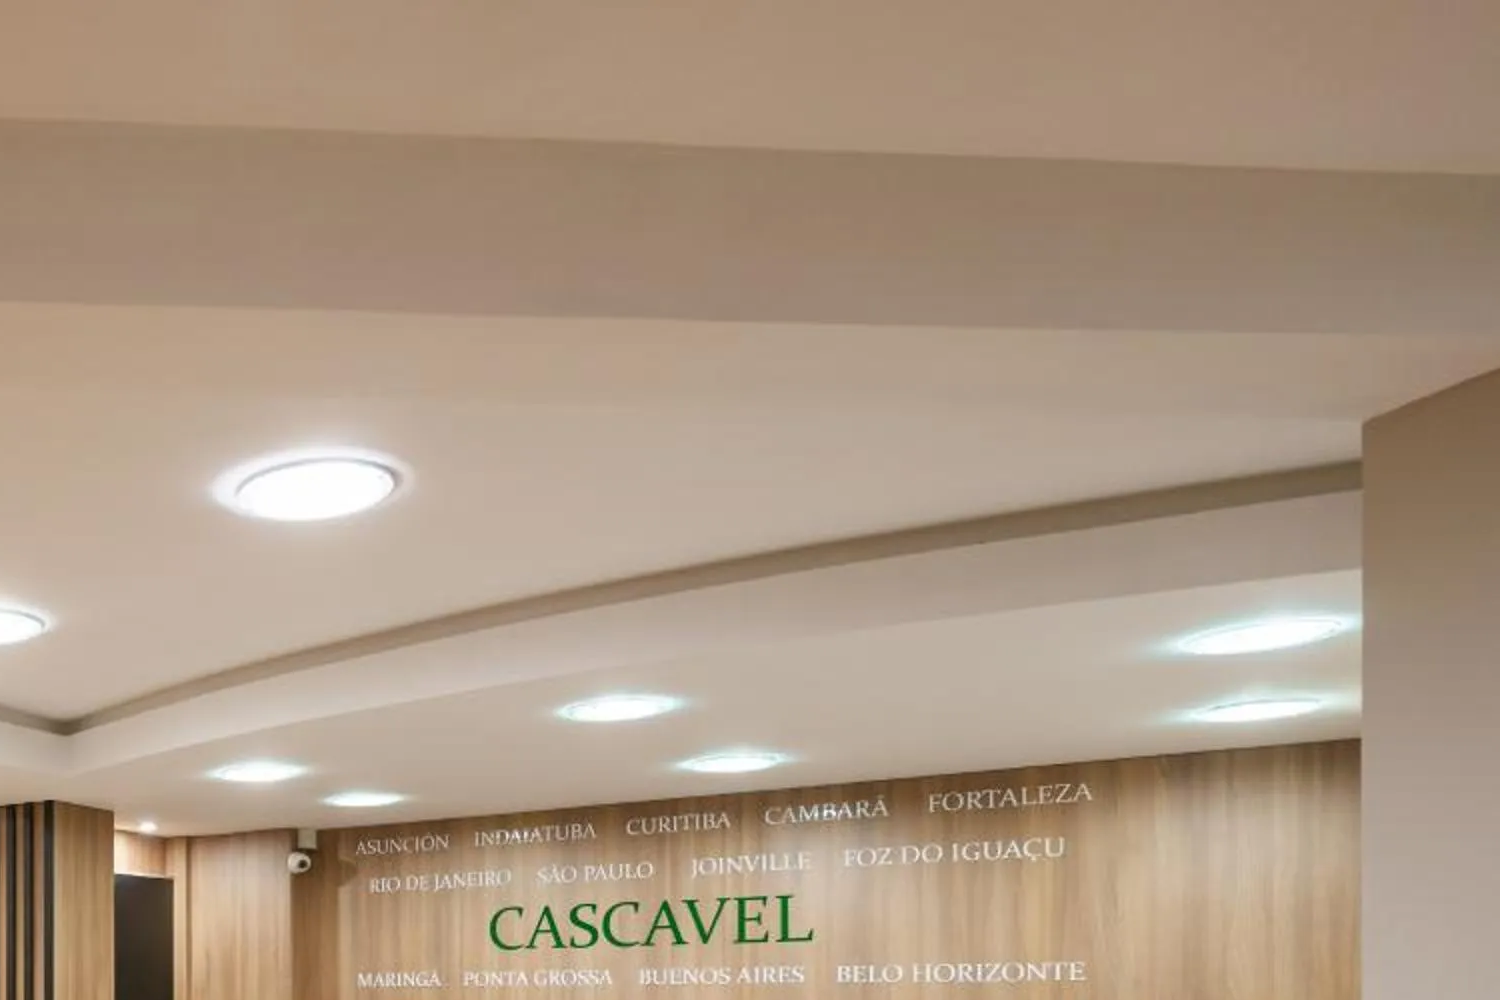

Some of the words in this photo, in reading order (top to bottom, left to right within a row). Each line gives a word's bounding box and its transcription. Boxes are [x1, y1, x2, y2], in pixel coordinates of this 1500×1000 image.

[474, 822, 597, 848] INDAIATUBA
[626, 811, 732, 836] CURITIBA
[765, 794, 890, 826] CAMBARÁ
[929, 783, 1094, 813] FORTALEZA
[369, 876, 401, 893] RIO
[404, 874, 430, 892] DE
[433, 867, 512, 892] JANEIRO
[584, 860, 654, 882] PAULO
[691, 851, 813, 879] JOINVILLE
[843, 847, 893, 867] FOZ
[901, 844, 943, 865] DO
[952, 836, 1066, 861] IGUAÇU
[489, 894, 813, 951] CASCAVEL
[462, 971, 528, 988] PONTA
[533, 968, 613, 987] GROSSA
[639, 967, 731, 986] BUENOS
[736, 965, 805, 984] AIRES
[836, 964, 904, 984] BELO
[913, 961, 1087, 983] HORIZONTE
